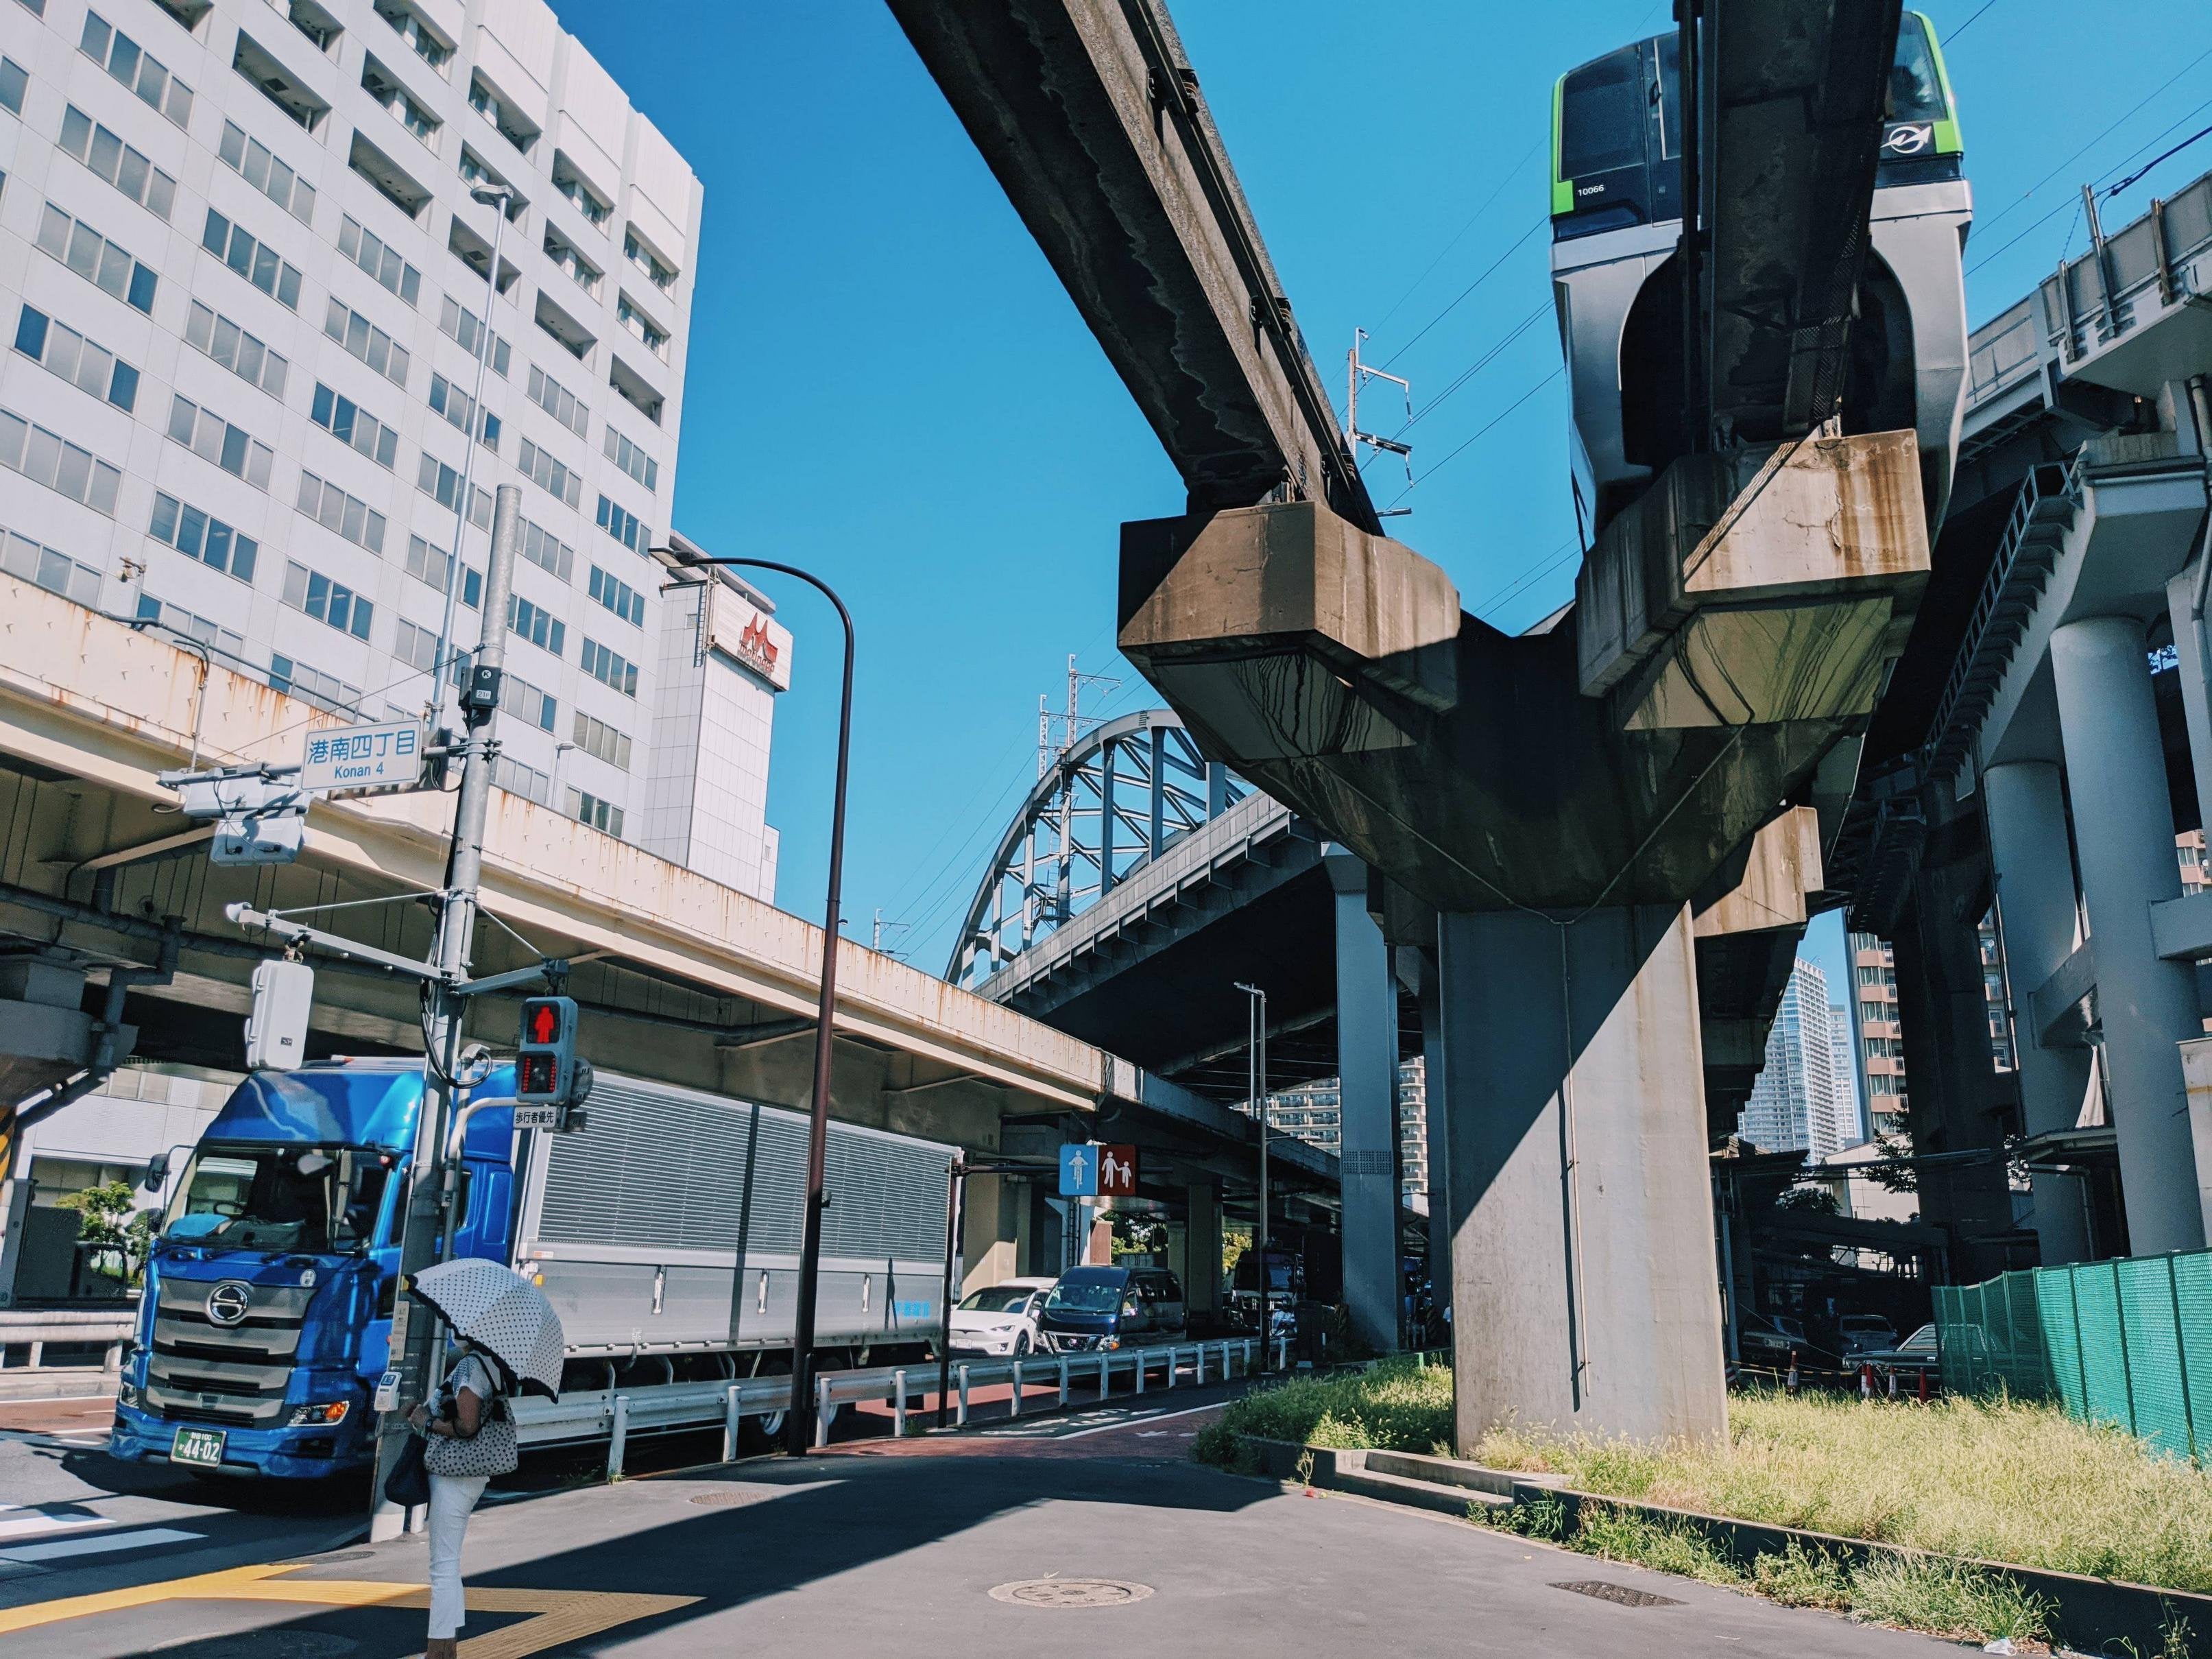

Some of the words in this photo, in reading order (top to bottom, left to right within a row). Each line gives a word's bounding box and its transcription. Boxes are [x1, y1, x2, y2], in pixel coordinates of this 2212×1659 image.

[1578, 184, 1604, 196] 10066
[307, 730, 416, 765] 港南四丁目
[335, 765, 371, 779] Konan
[376, 762, 384, 775] 4
[516, 1110, 554, 1123] 歩行者優先
[183, 1439, 220, 1461] 44-02
